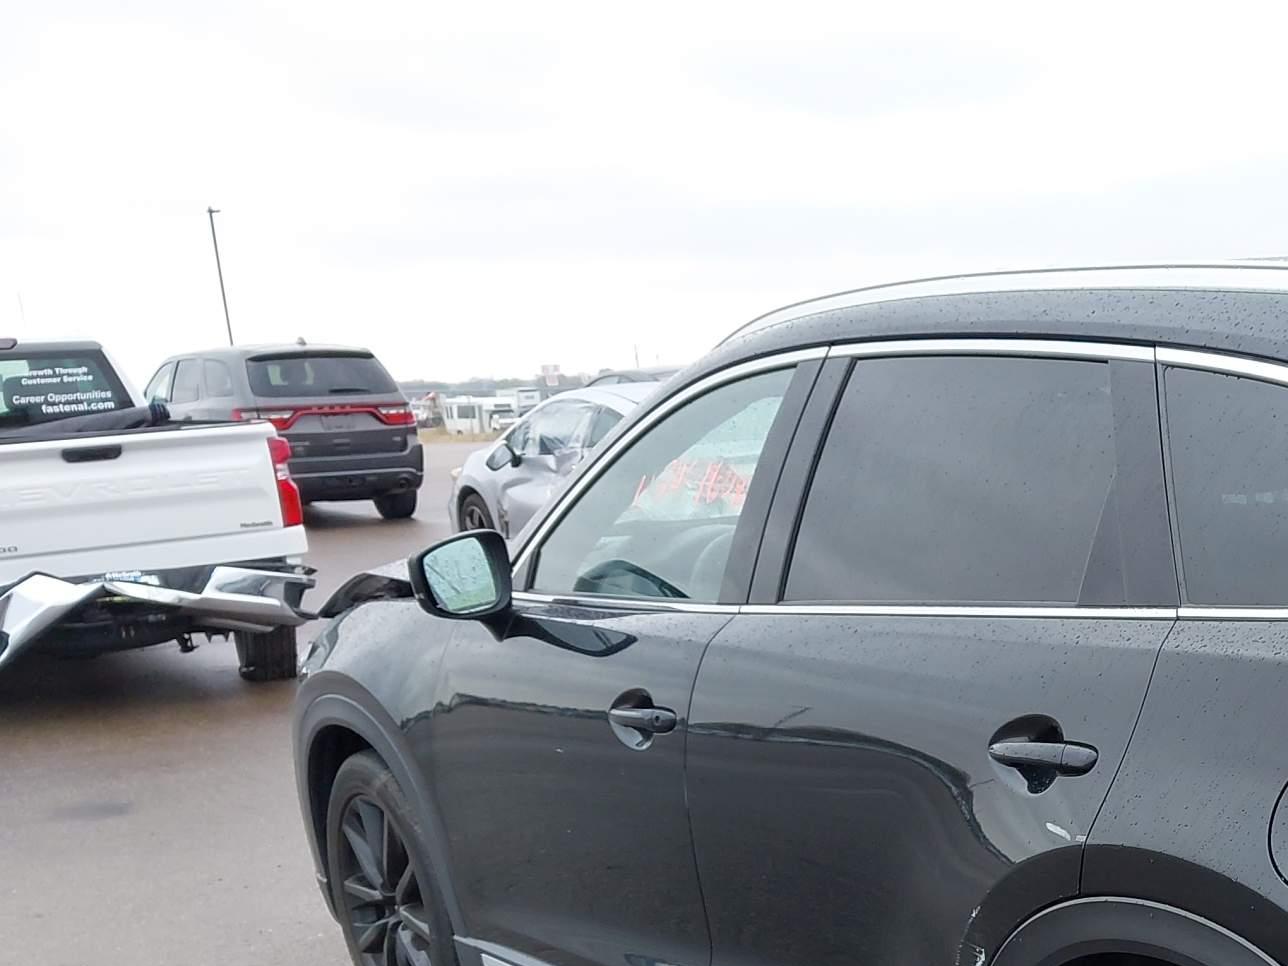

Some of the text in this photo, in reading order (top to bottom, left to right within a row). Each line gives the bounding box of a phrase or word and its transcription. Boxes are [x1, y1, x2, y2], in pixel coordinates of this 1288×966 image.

[54, 366, 88, 375] Through
[21, 374, 94, 386] Customer Service
[12, 390, 112, 405] Career Opportunities
[41, 401, 115, 414] fastenal.com
